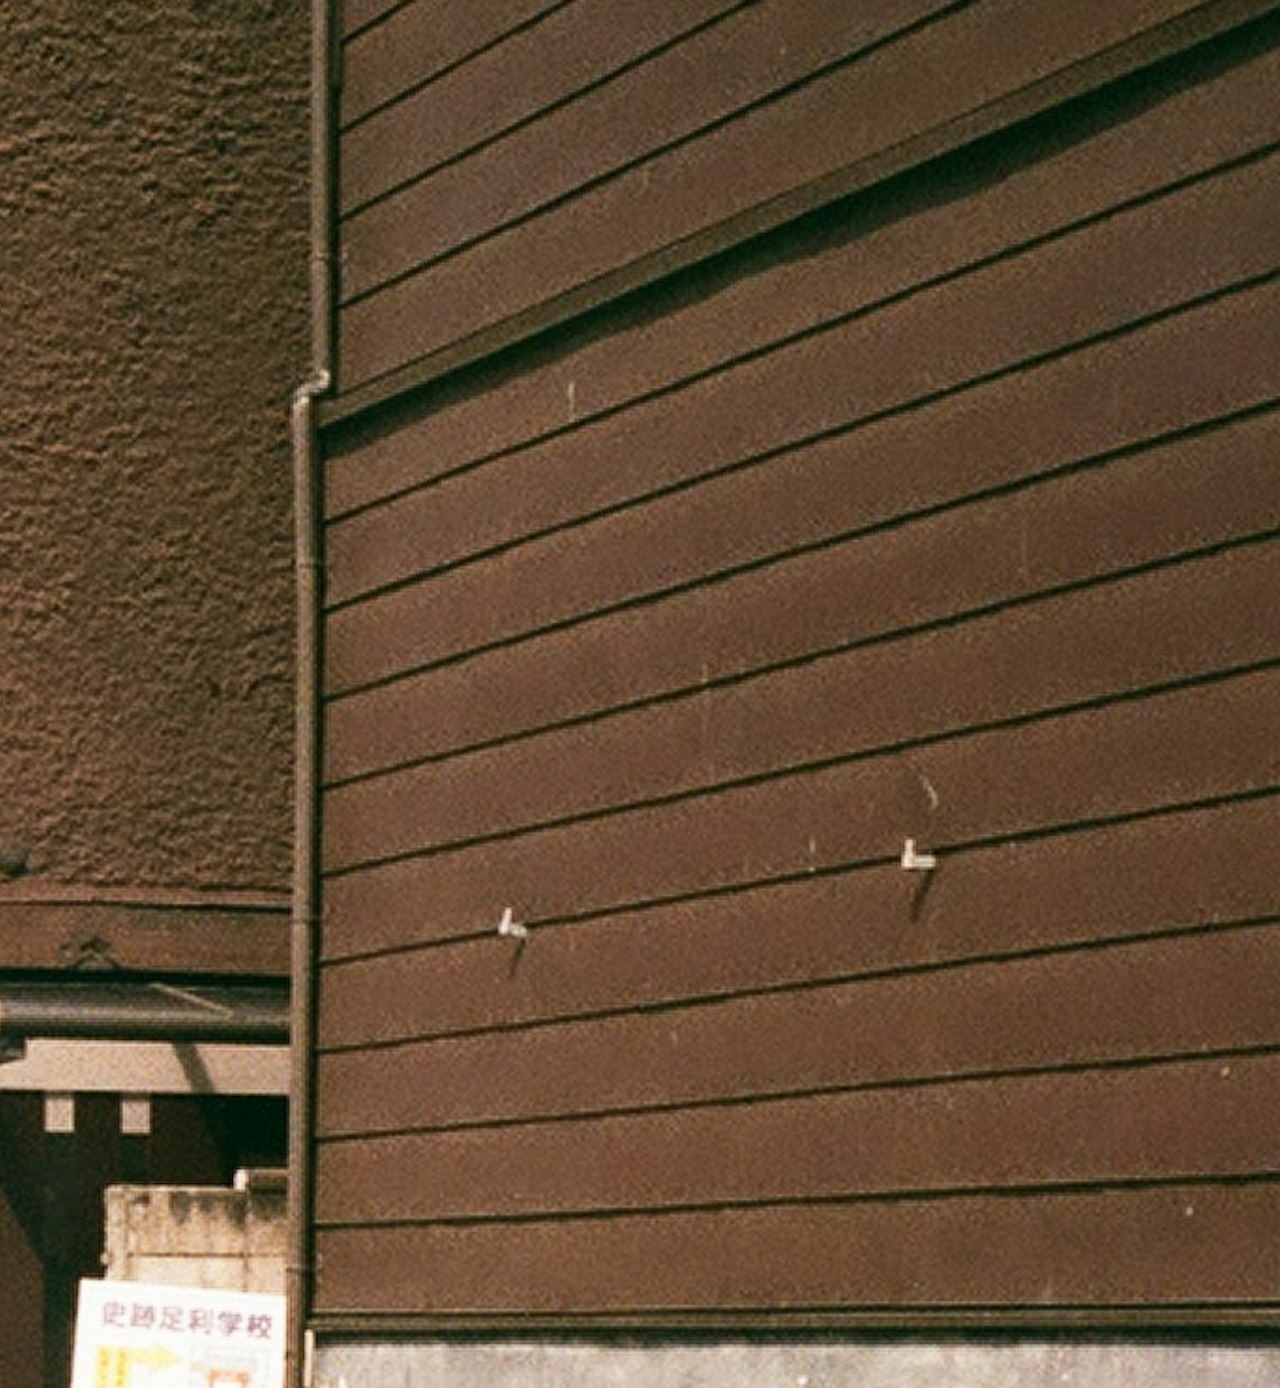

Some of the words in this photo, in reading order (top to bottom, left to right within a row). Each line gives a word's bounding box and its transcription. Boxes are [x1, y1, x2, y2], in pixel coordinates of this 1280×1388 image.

[101, 1300, 273, 1340] 史跡足利学校
